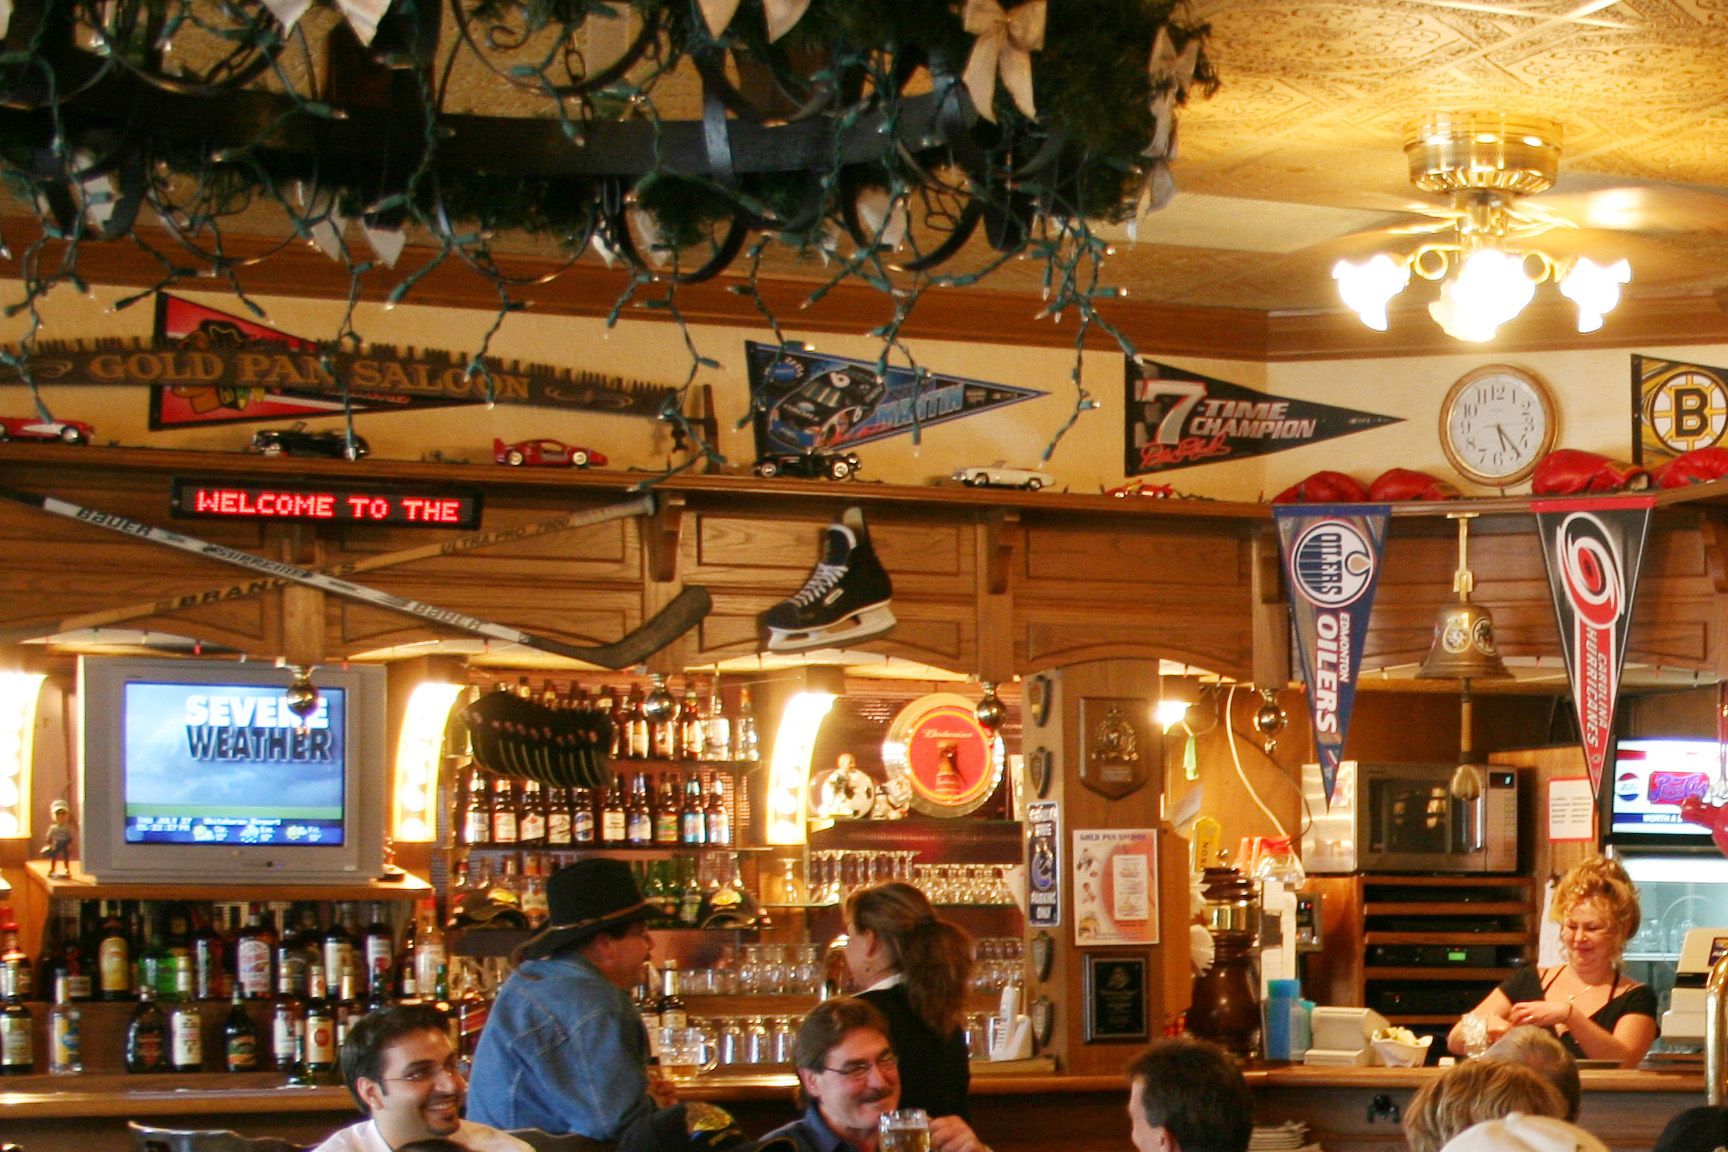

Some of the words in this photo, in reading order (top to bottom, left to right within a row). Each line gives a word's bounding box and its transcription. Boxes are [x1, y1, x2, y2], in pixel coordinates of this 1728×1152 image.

[88, 352, 225, 381] GOLD
[238, 354, 337, 384] PAN
[351, 360, 530, 400] SALOON
[1490, 385, 1506, 401] 12
[1143, 379, 1208, 446] 7
[1462, 404, 1478, 419] 10
[1521, 401, 1531, 416] 2
[1524, 417, 1534, 433] 3
[1674, 388, 1710, 439] B
[1189, 418, 1317, 439] CHAMPION
[1460, 420, 1471, 434] 9
[1465, 437, 1476, 451] 8
[1478, 448, 1487, 464] 7
[1493, 453, 1503, 466] 6
[194, 488, 337, 518] WELCOME
[347, 496, 390, 520] TO
[401, 499, 462, 523] THE
[1320, 532, 1343, 596] OILERS
[1339, 611, 1352, 683] EDMONTON
[1316, 614, 1338, 734] OILERS
[1586, 626, 1599, 748] HURRICANES
[1597, 652, 1608, 729] CAROLINA
[187, 726, 333, 763] WEATHER
